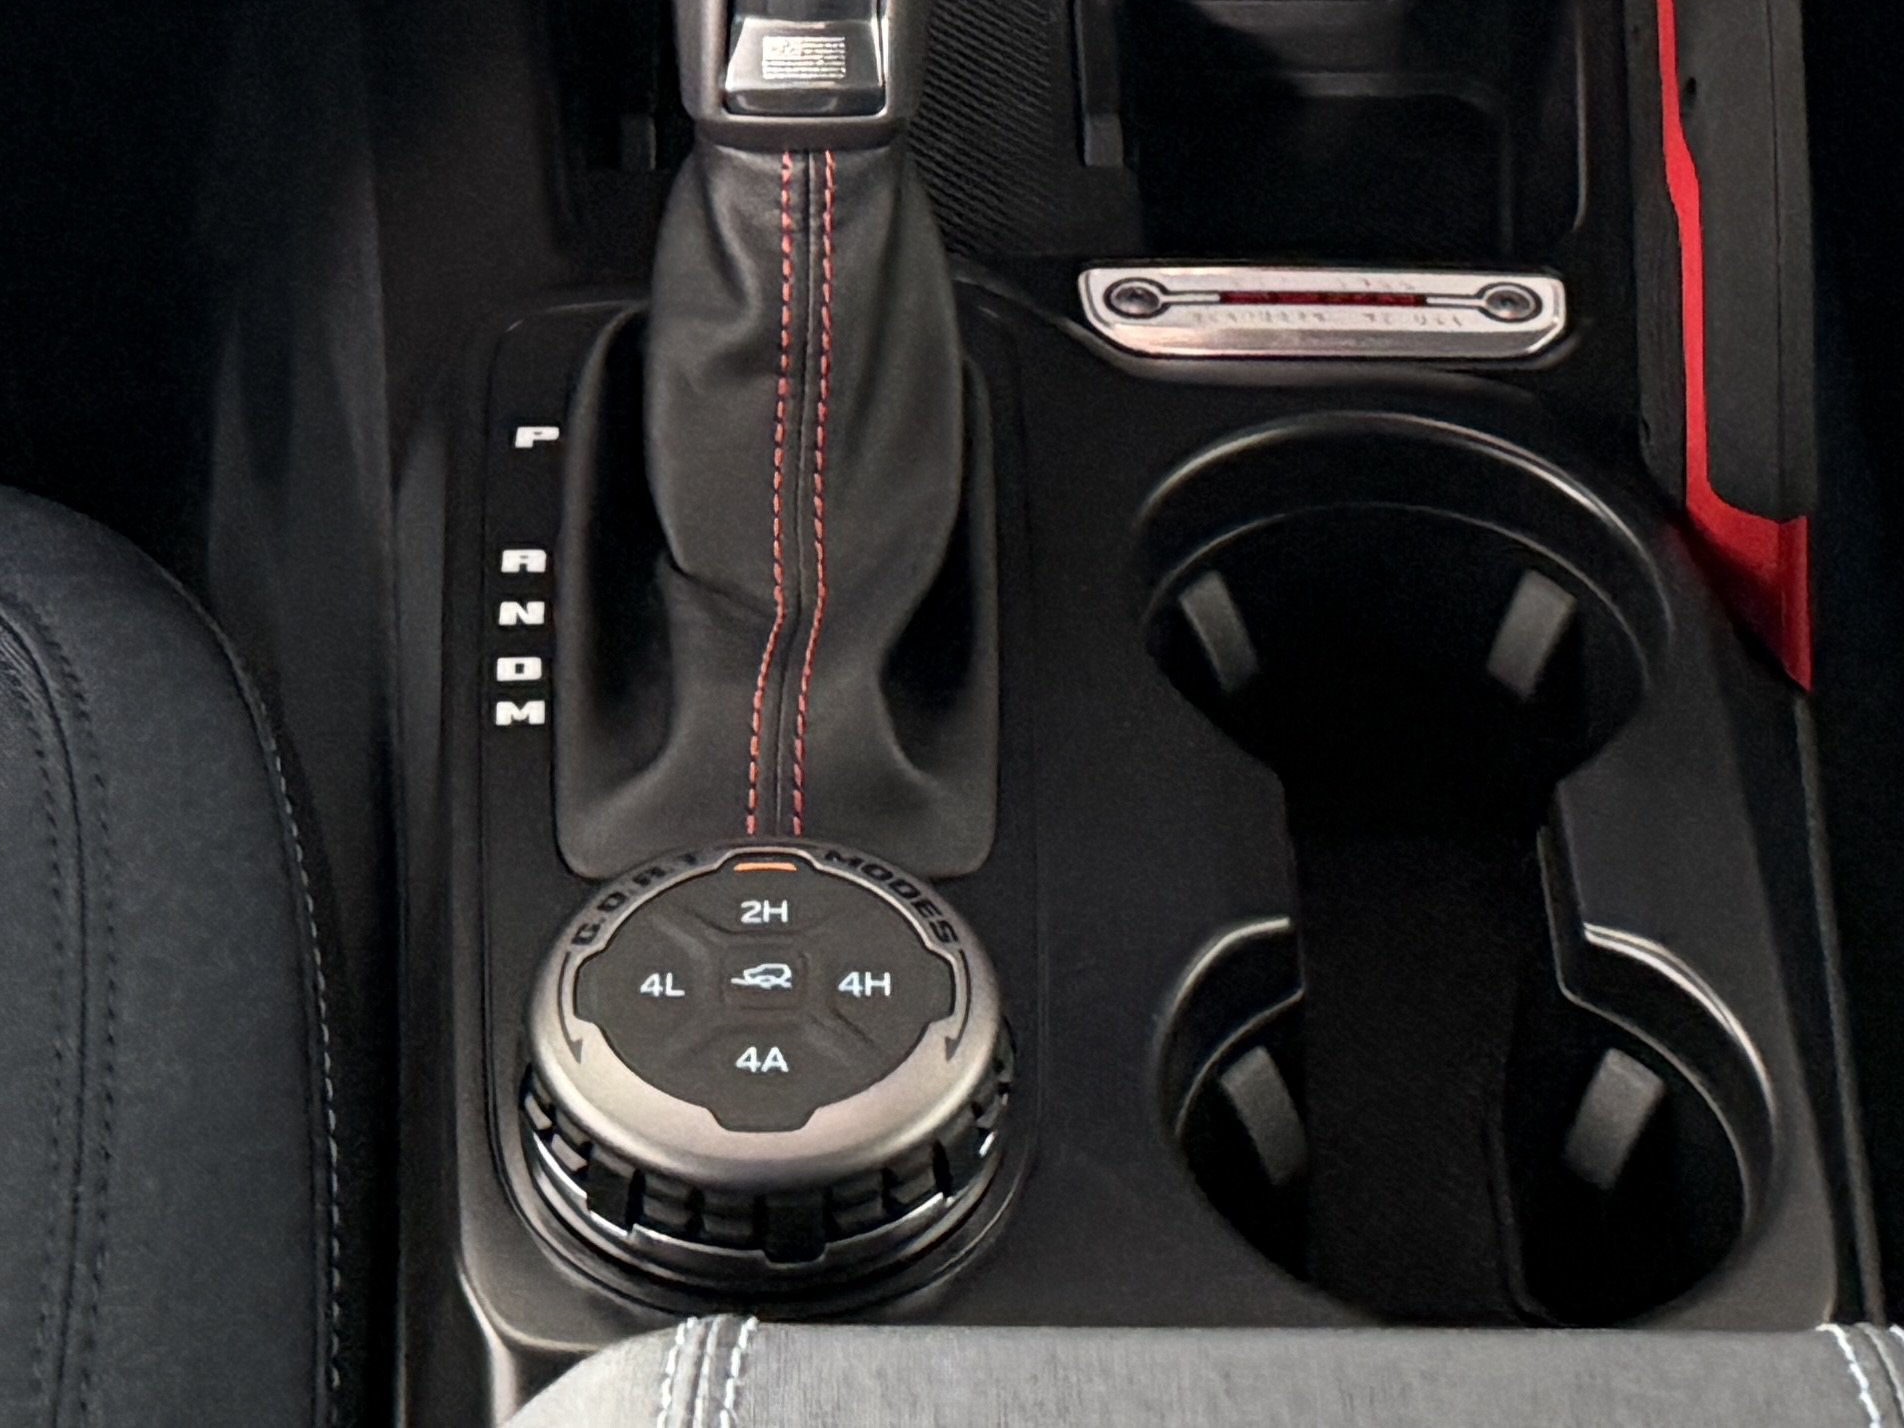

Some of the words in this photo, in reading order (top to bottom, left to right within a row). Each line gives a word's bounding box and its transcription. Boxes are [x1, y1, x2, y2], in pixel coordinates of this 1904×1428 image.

[514, 426, 560, 448] P
[500, 548, 547, 573] R
[498, 600, 545, 626] N
[495, 700, 546, 726] M
[825, 848, 959, 944] MODES
[740, 899, 789, 924] 2H
[639, 972, 686, 997] 4L
[838, 971, 891, 998] 4H
[735, 1046, 789, 1073] 4A
